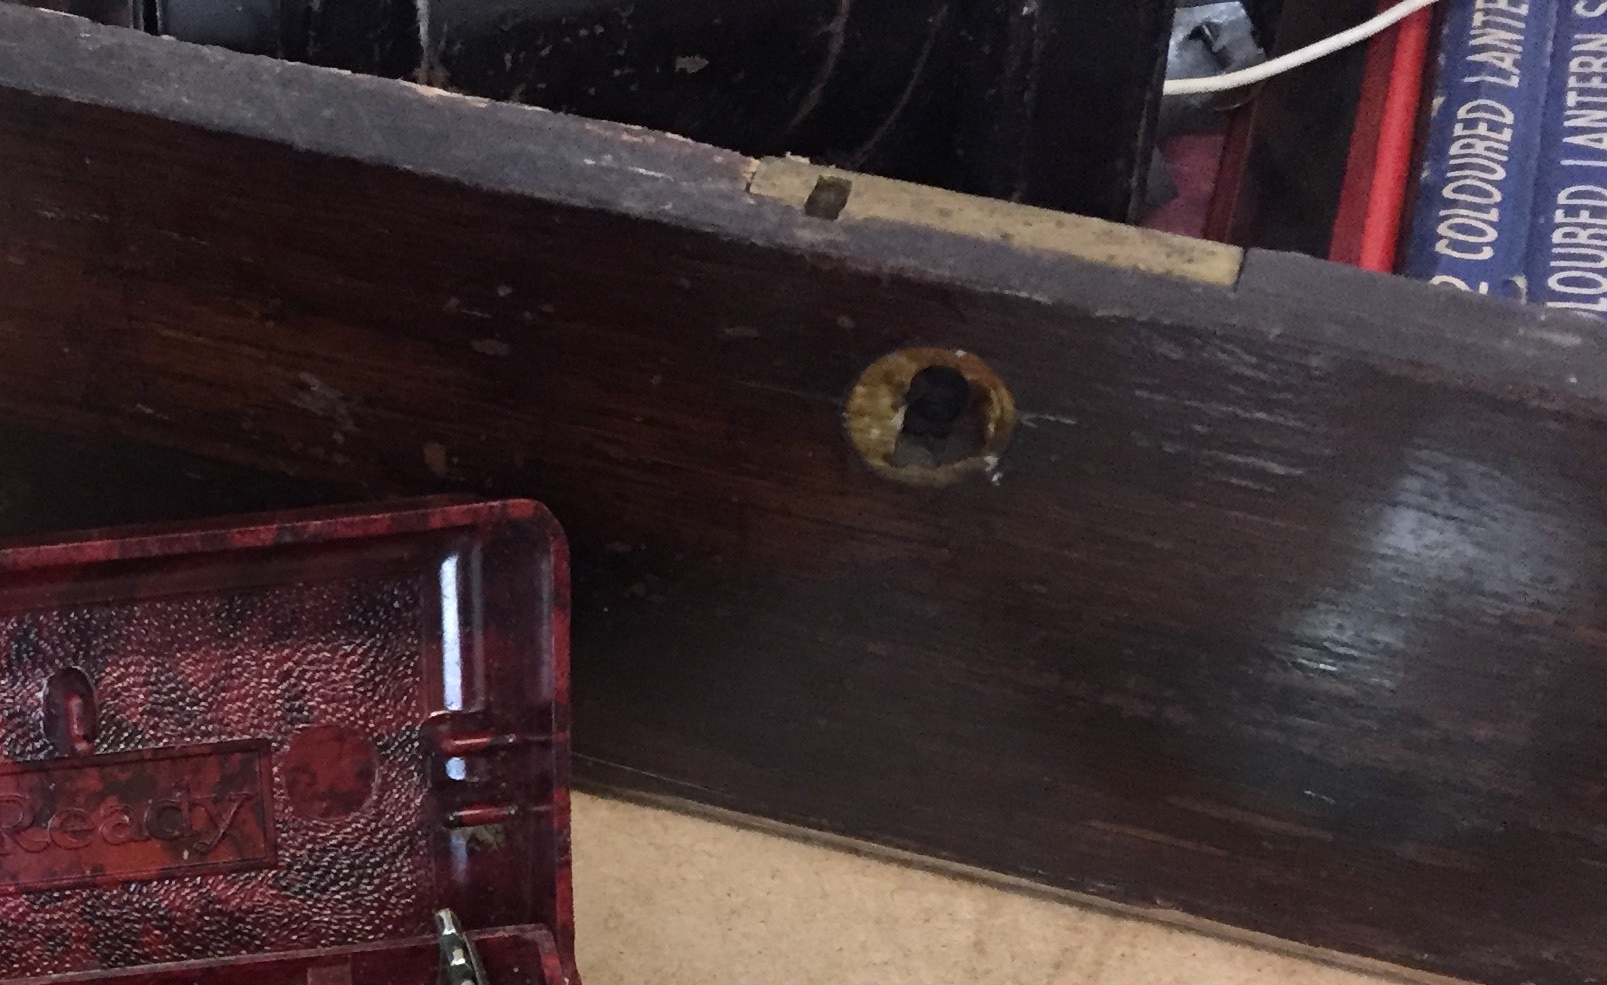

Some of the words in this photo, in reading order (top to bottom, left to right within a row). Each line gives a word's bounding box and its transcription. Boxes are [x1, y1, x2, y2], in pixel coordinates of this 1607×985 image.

[1460, 0, 1530, 88] LANTE
[1433, 98, 1515, 261] COLOURED
[1544, 183, 1607, 313] LOURED
